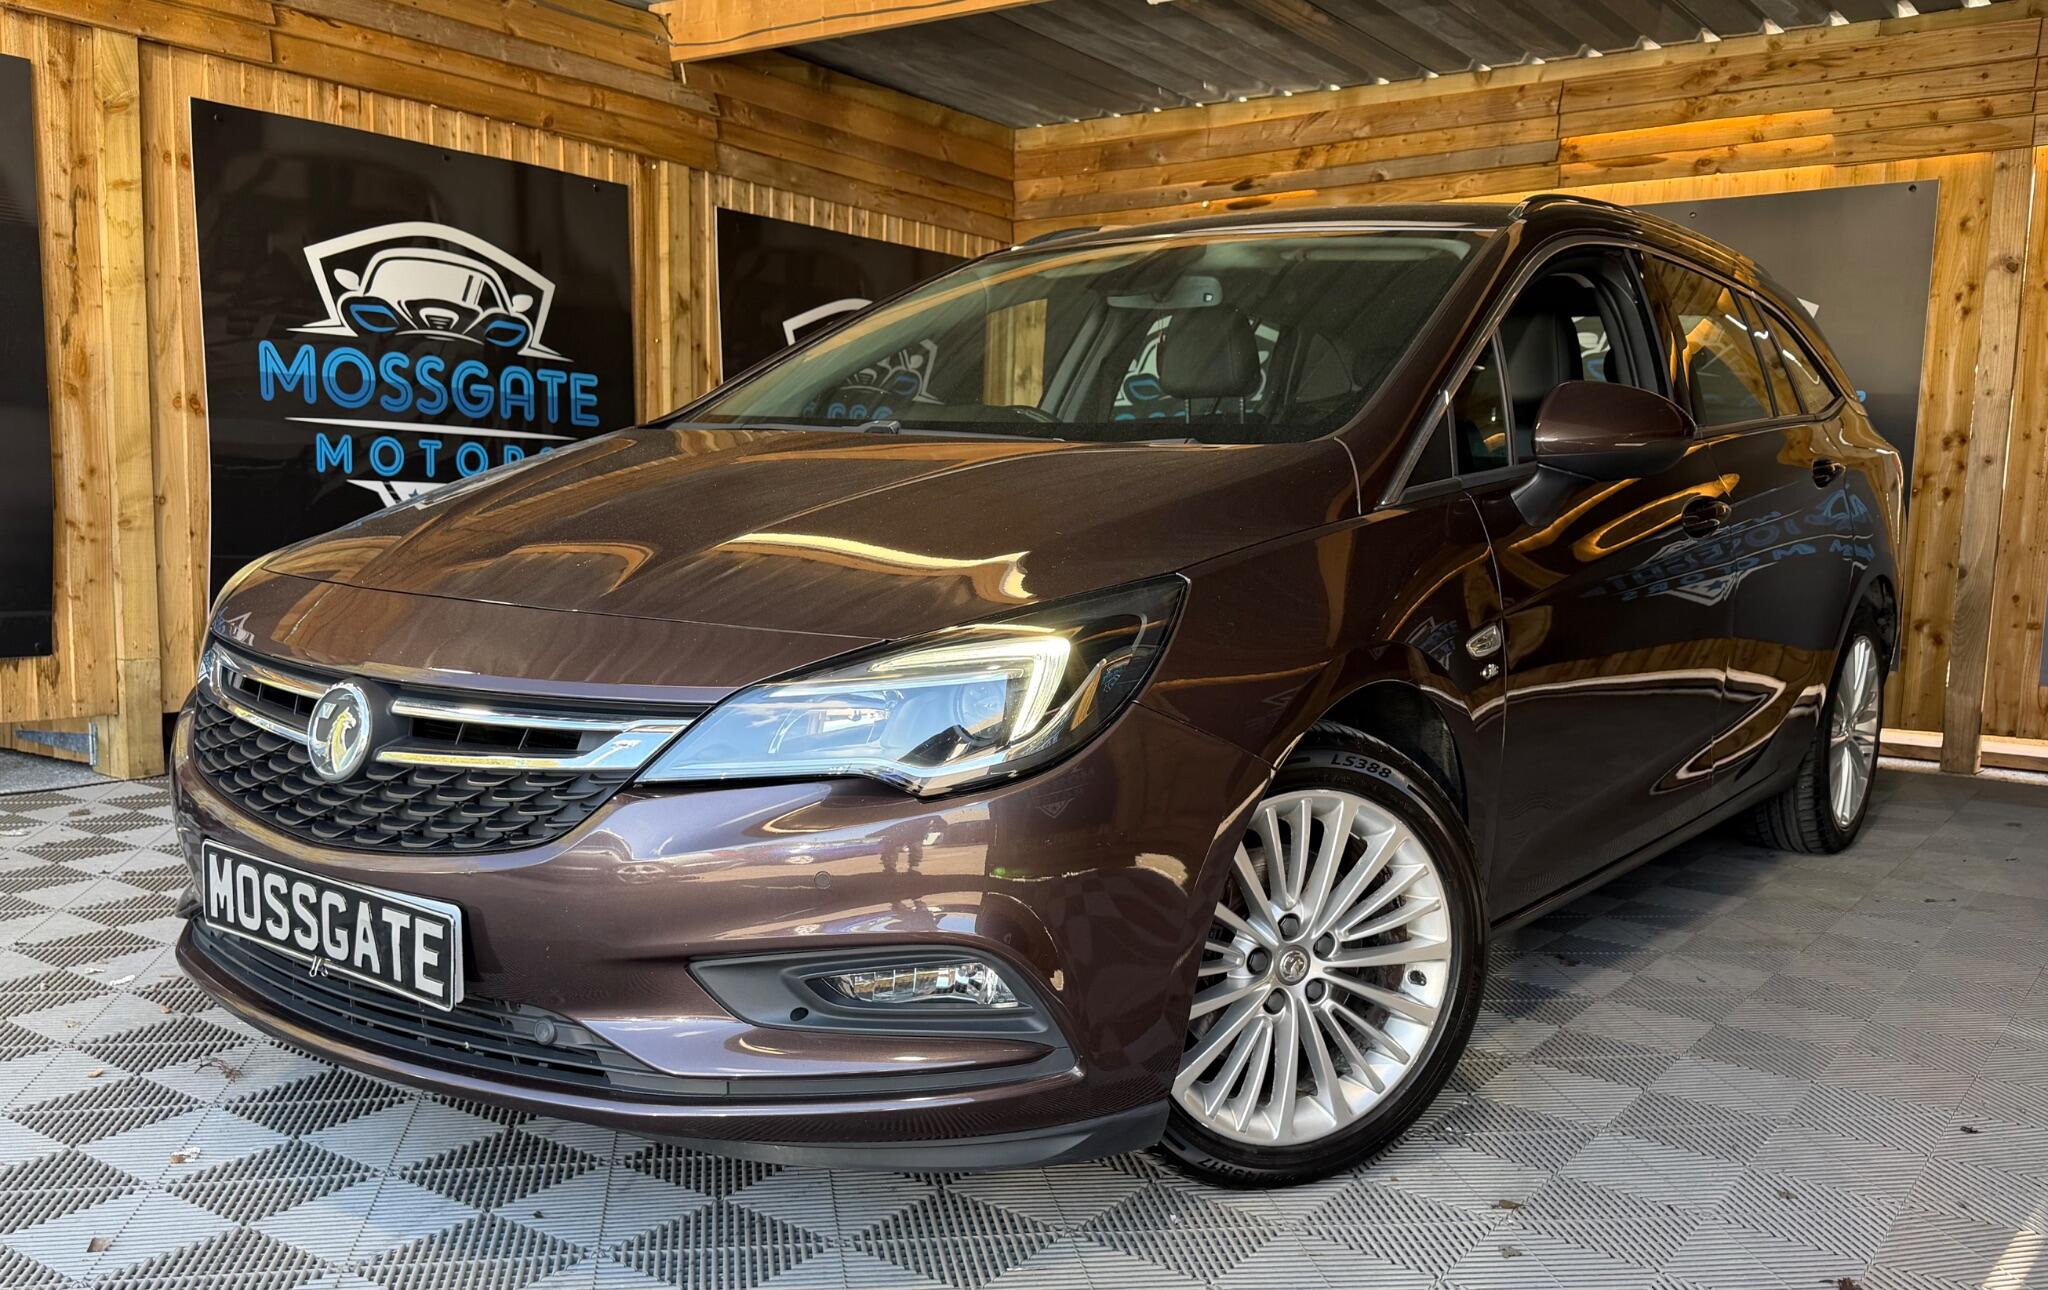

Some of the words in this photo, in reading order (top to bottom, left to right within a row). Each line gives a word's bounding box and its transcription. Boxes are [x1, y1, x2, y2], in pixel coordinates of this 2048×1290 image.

[258, 340, 600, 427] MOSSGATE
[1330, 753, 1392, 779] LS388
[208, 852, 445, 998] MOSSGATE
